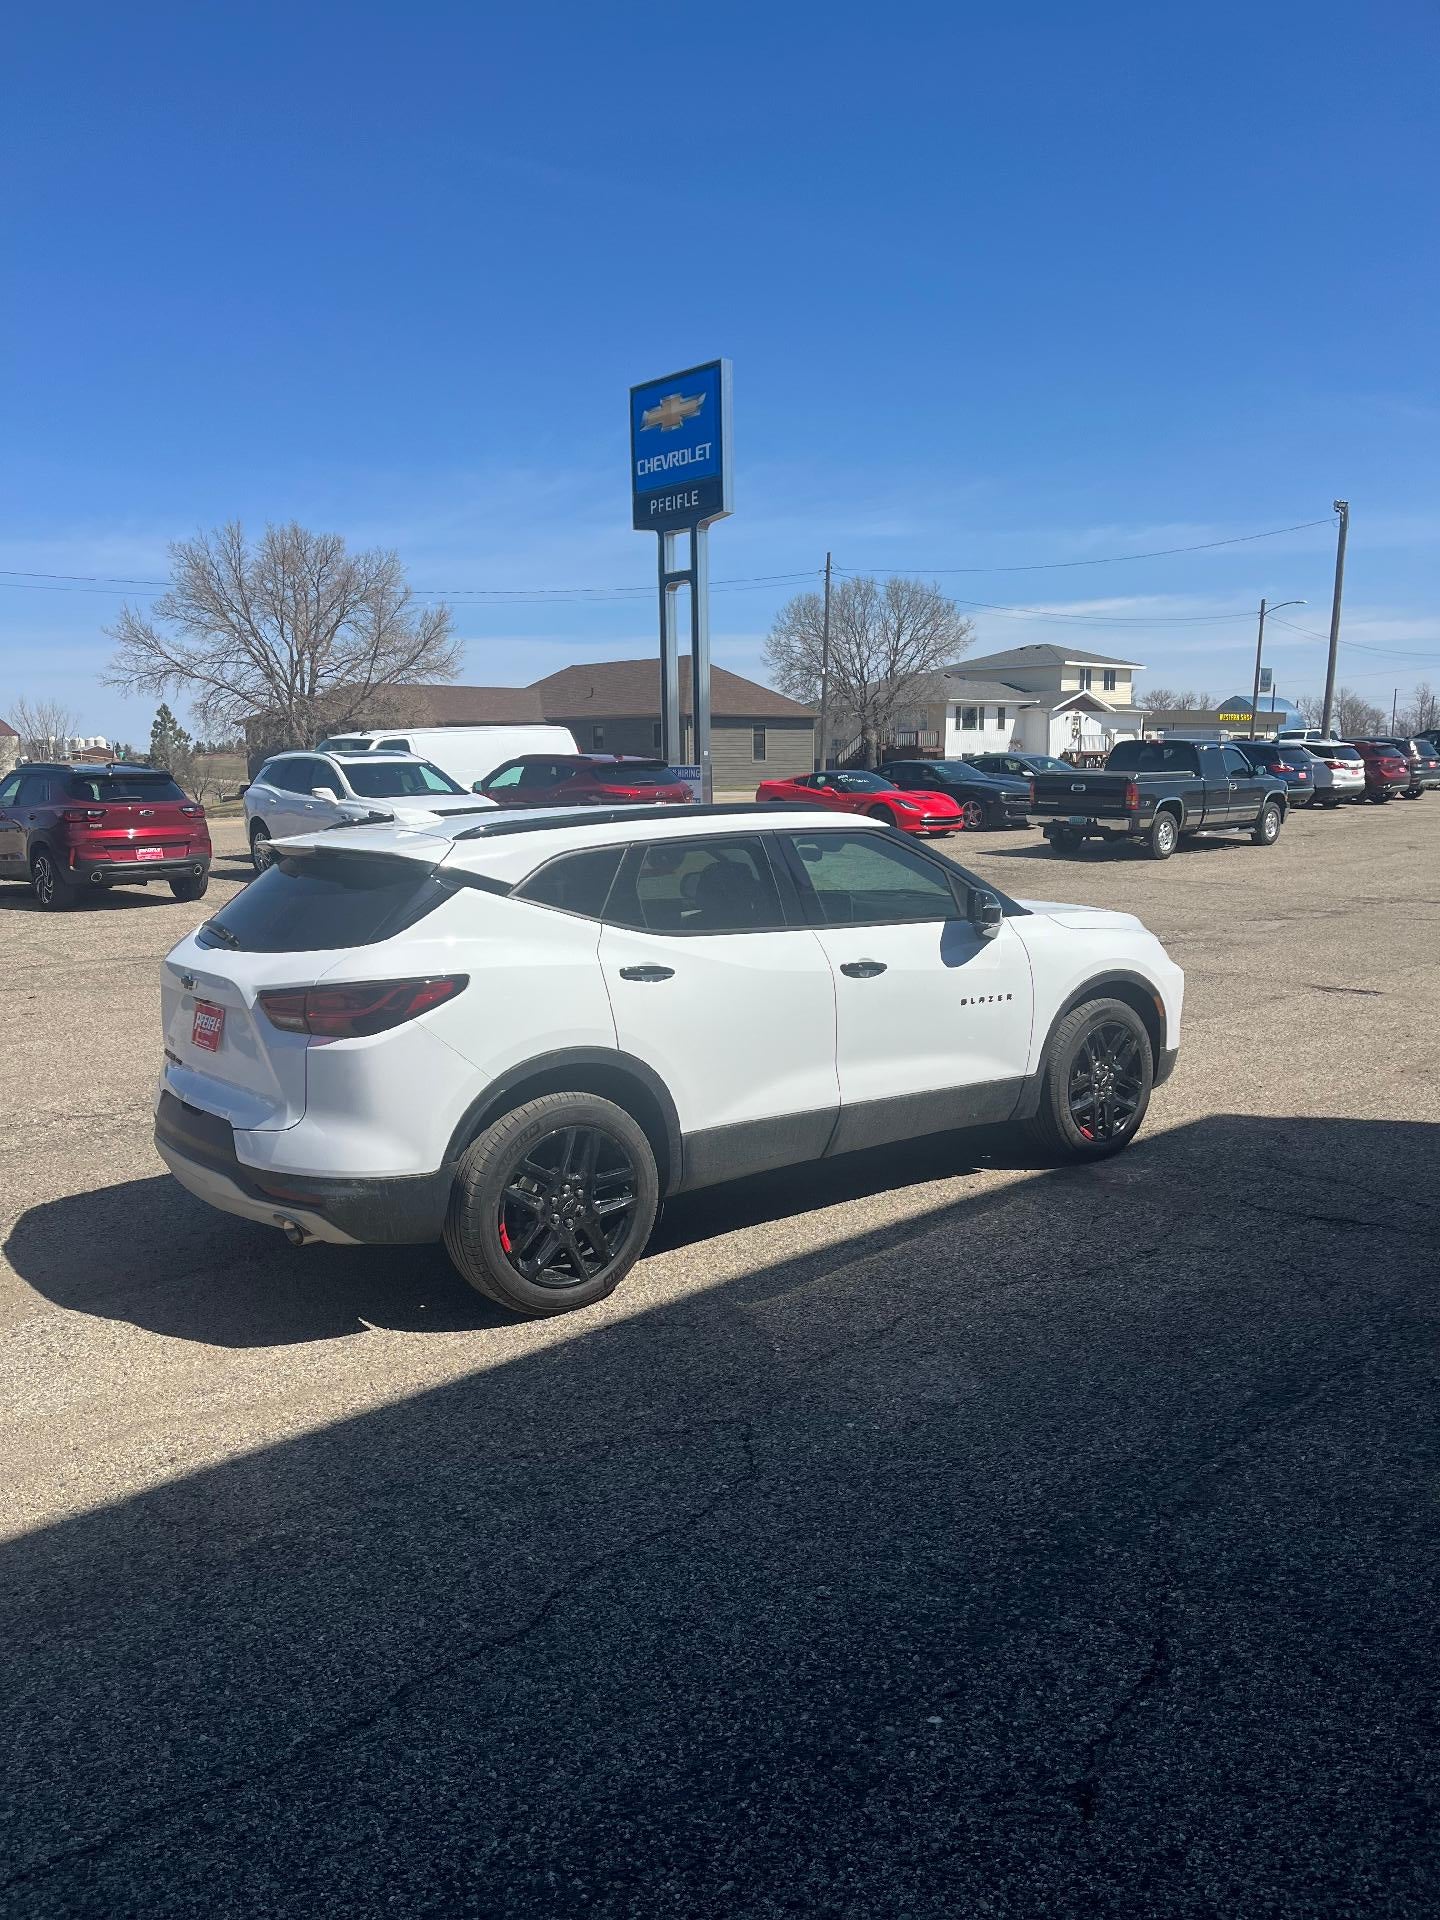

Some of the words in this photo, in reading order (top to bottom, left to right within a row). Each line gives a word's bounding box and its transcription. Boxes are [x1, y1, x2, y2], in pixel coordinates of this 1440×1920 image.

[637, 443, 712, 476] CHEVROLET
[650, 490, 699, 514] PFEIFLE
[677, 769, 700, 778] HIRING
[960, 993, 1013, 1006] BLAZER
